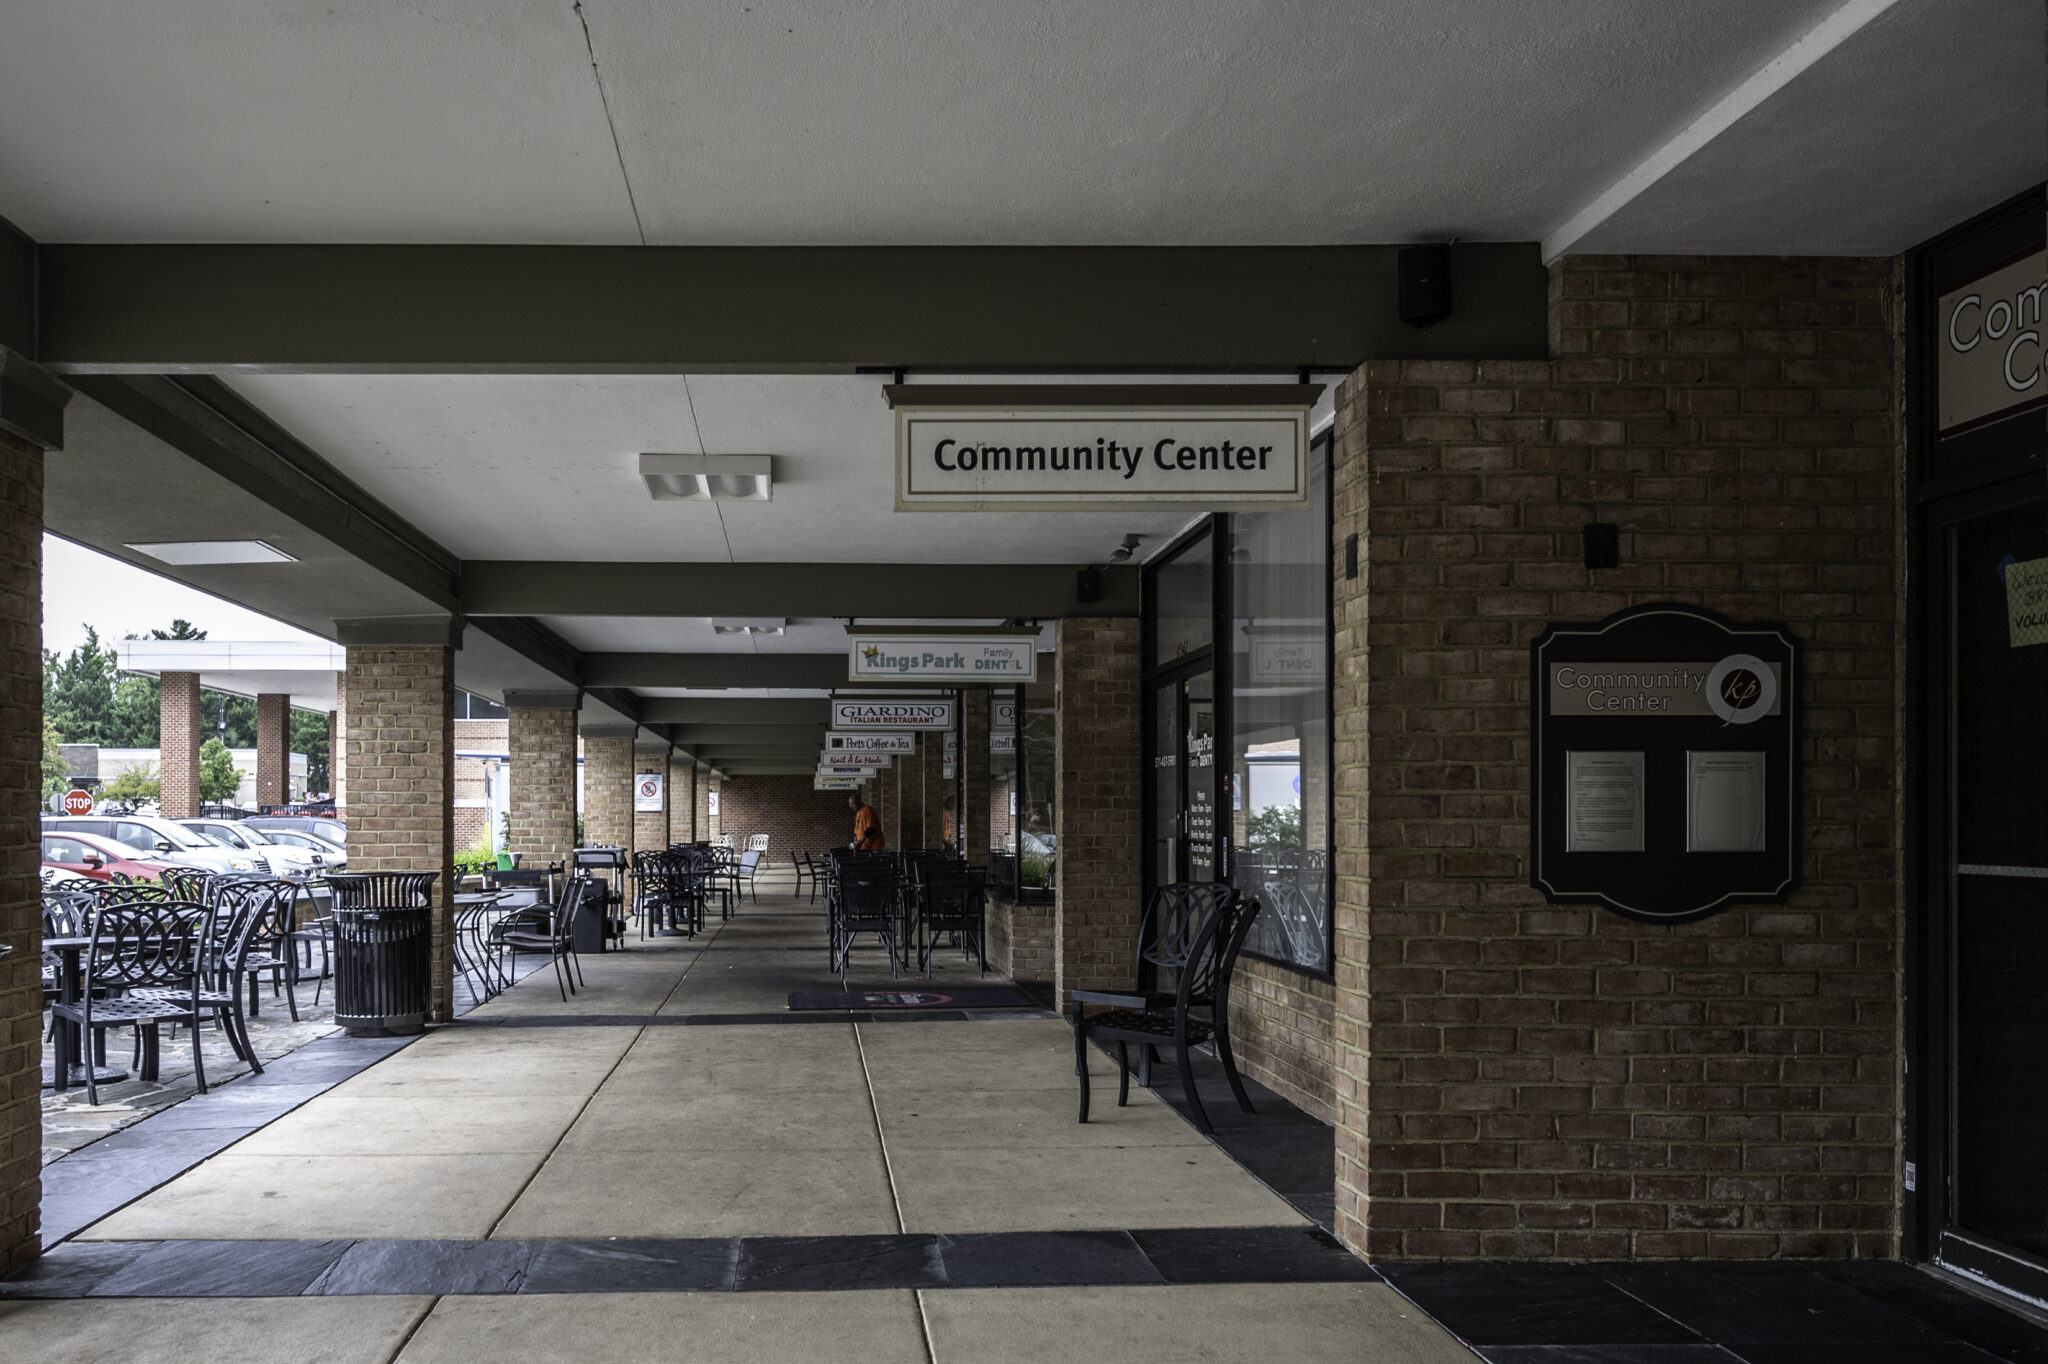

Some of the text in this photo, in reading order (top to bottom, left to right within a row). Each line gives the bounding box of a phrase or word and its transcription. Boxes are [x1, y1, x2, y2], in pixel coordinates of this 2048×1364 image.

[934, 437, 1273, 480] Community Center
[983, 648, 1014, 659] Family
[866, 652, 965, 672] Kings Park
[1555, 666, 1706, 694] Community
[1586, 690, 1672, 712] Center
[840, 706, 945, 718] GIARDINO
[866, 737, 890, 750] Coffee
[896, 737, 910, 749] Tea
[829, 755, 846, 765] Nail
[864, 755, 882, 764] Mode
[66, 798, 91, 809] STOP
